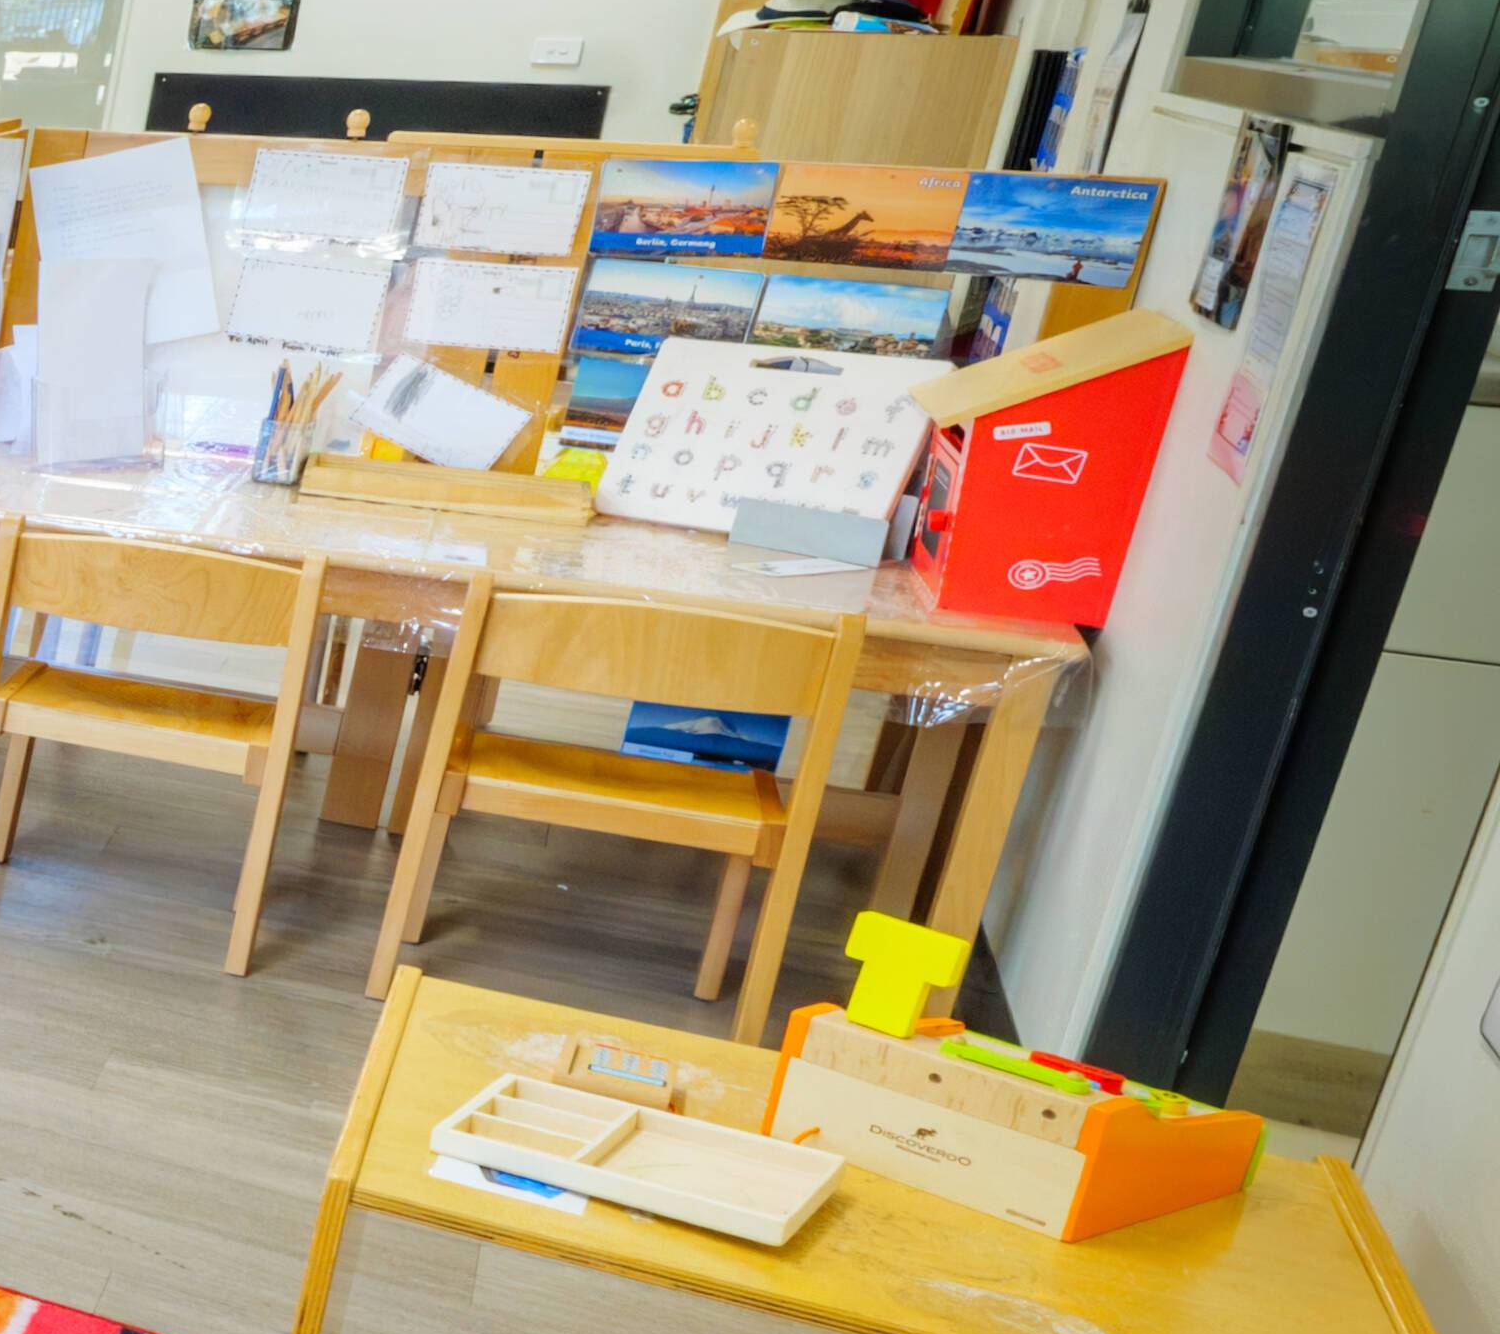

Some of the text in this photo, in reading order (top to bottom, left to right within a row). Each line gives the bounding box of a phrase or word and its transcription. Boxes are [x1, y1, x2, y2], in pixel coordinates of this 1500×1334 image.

[919, 175, 962, 189] Africa
[1070, 185, 1149, 201] Antarctica
[636, 237, 717, 250] Berlin, Germany
[625, 338, 653, 350] Paris,
[662, 380, 684, 398] a
[702, 375, 725, 401] b
[748, 388, 768, 406] c
[790, 386, 821, 412] d
[886, 394, 915, 424] f
[646, 412, 669, 438] g
[685, 410, 706, 435] h
[725, 420, 740, 439] i
[751, 424, 777, 450] j
[790, 422, 813, 448] k
[861, 436, 895, 457] m
[674, 449, 694, 466] o
[714, 454, 742, 481] p
[766, 460, 791, 488] q
[810, 463, 835, 483] r
[617, 473, 635, 495] t
[651, 482, 672, 499] u
